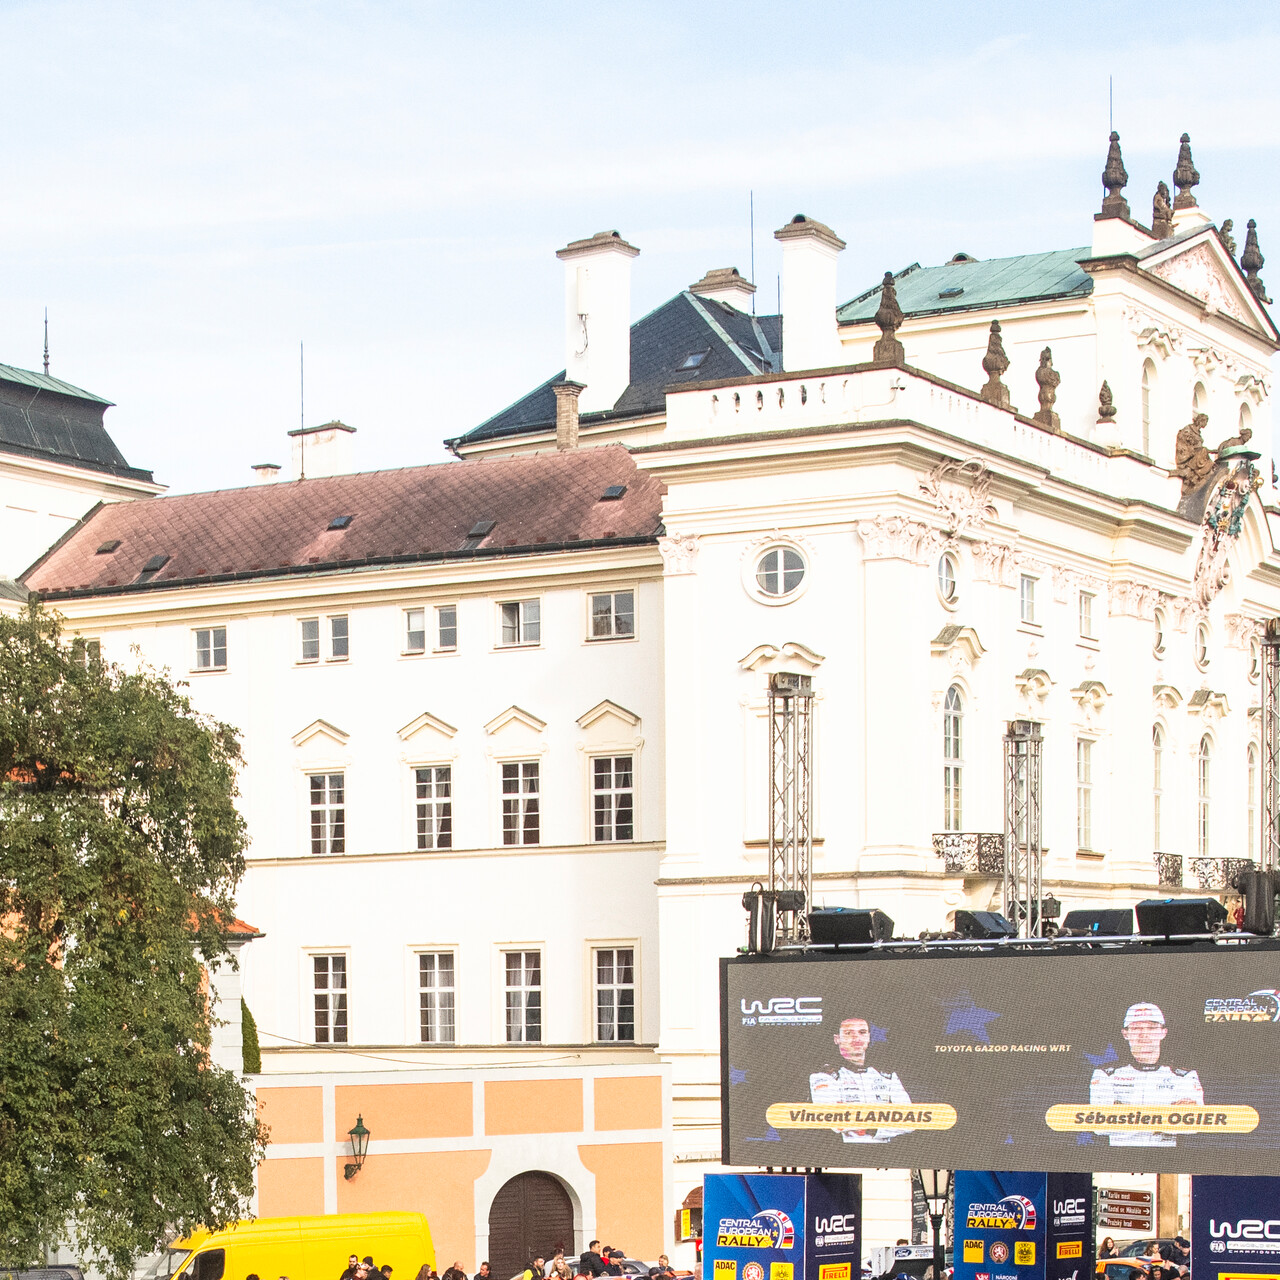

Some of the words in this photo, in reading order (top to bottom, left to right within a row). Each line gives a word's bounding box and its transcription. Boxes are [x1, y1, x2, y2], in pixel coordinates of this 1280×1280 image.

[741, 997, 822, 1014] WRC
[1204, 1006, 1268, 1014] EUROPEAN
[742, 1017, 757, 1026] FIA
[1204, 1014, 1256, 1022] RALLY
[1011, 1044, 1047, 1052] RACING
[789, 1109, 851, 1122] Vincent
[855, 1110, 933, 1123] LANDAIS
[1074, 1111, 1163, 1126] Sébastien
[1168, 1112, 1227, 1126] OGIER
[969, 1203, 1007, 1211] CENTRAL
[1054, 1198, 1085, 1215] WRC
[720, 1219, 763, 1227] CENTRAL
[815, 1214, 855, 1233] WRC
[967, 1218, 1009, 1228] RALLY
[719, 1228, 771, 1236] EUROPEAN
[717, 1235, 764, 1246] RALLY
[964, 1241, 983, 1249] ADAC
[1059, 1244, 1080, 1256] PIRELLI
[715, 1261, 736, 1270] ADAC
[822, 1267, 848, 1280] PIRELLI
